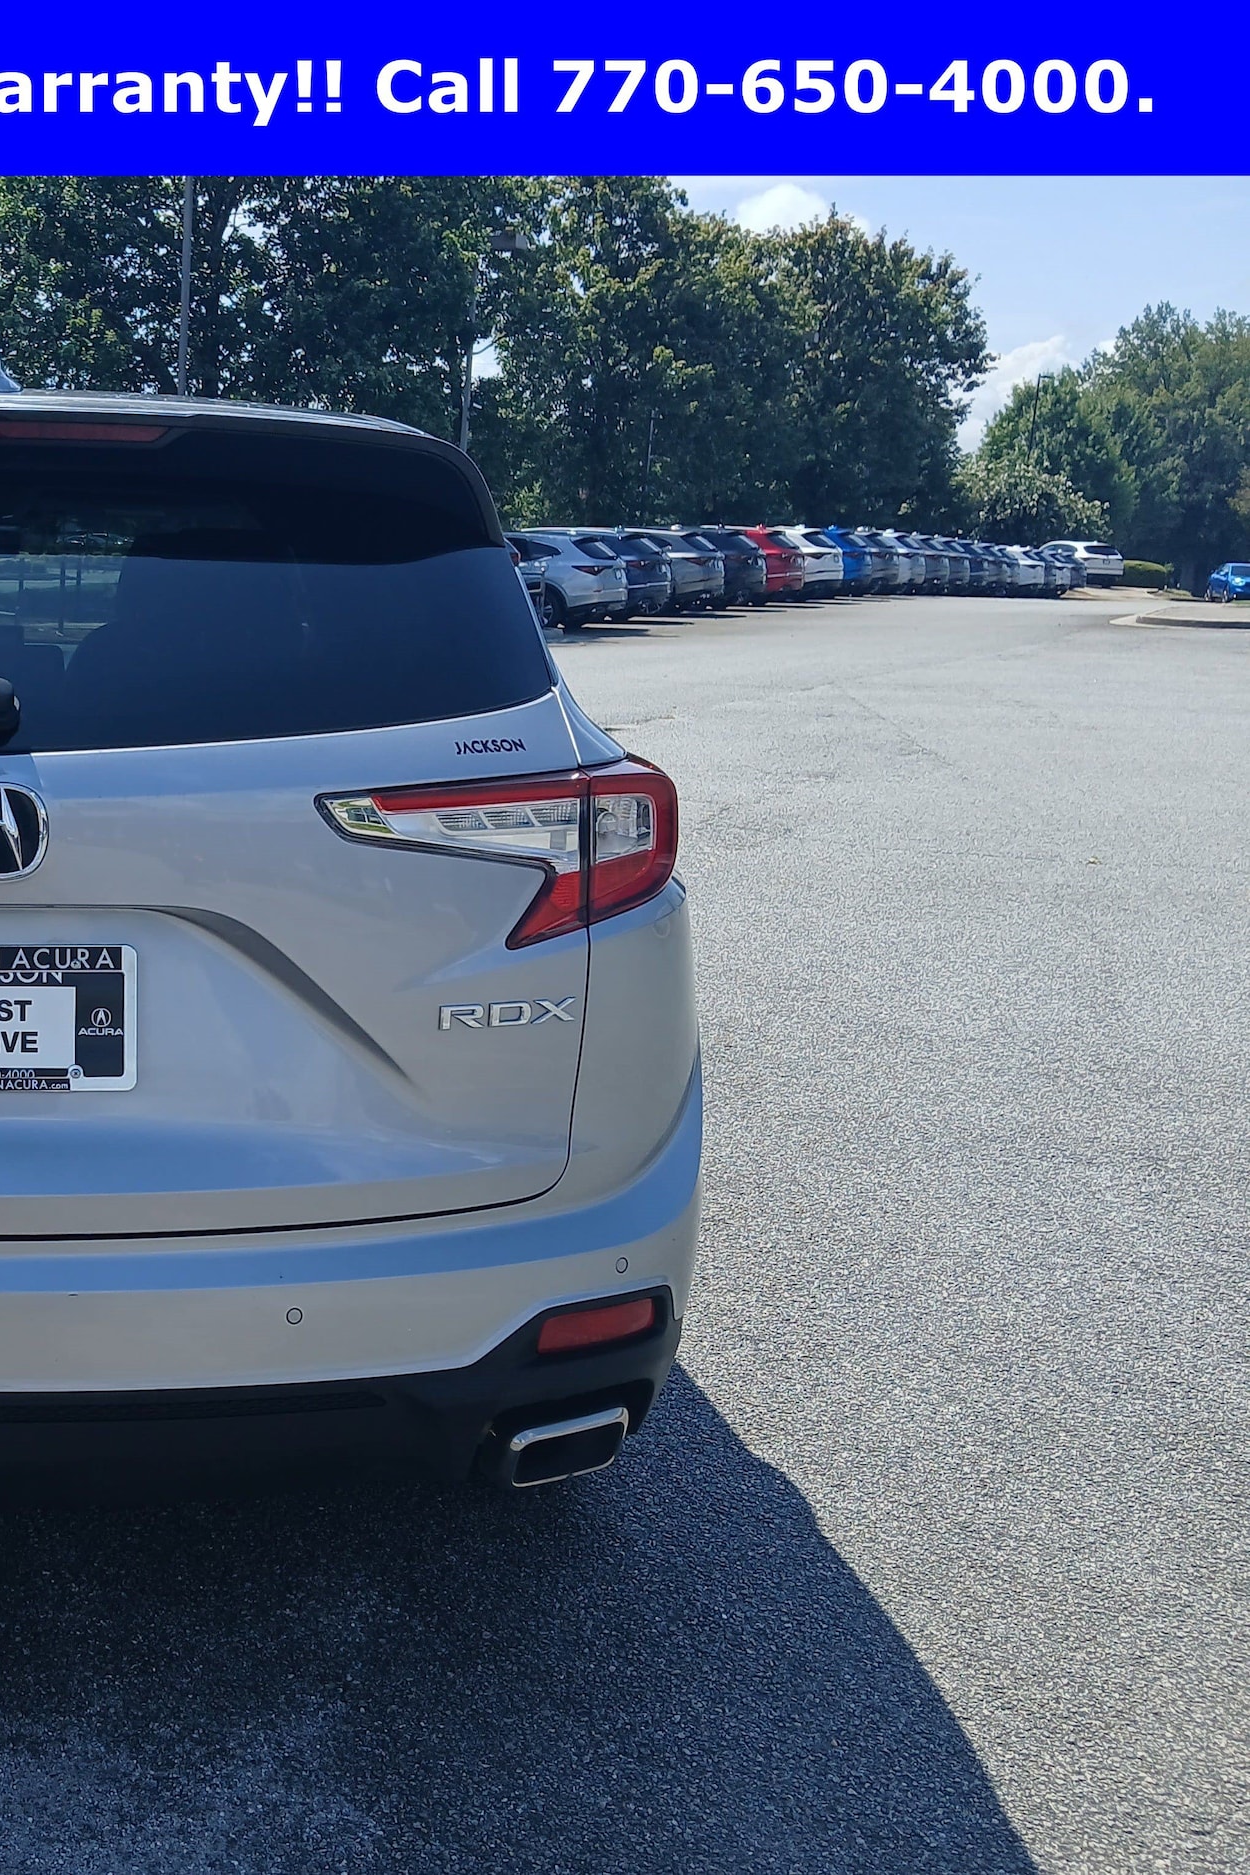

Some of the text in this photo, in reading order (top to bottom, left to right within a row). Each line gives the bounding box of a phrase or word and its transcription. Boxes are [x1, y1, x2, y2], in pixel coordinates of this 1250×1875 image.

[454, 738, 527, 756] JACKSON
[10, 948, 116, 969] ACURA
[438, 996, 577, 1031] RDX
[78, 1027, 125, 1036] ACURA
